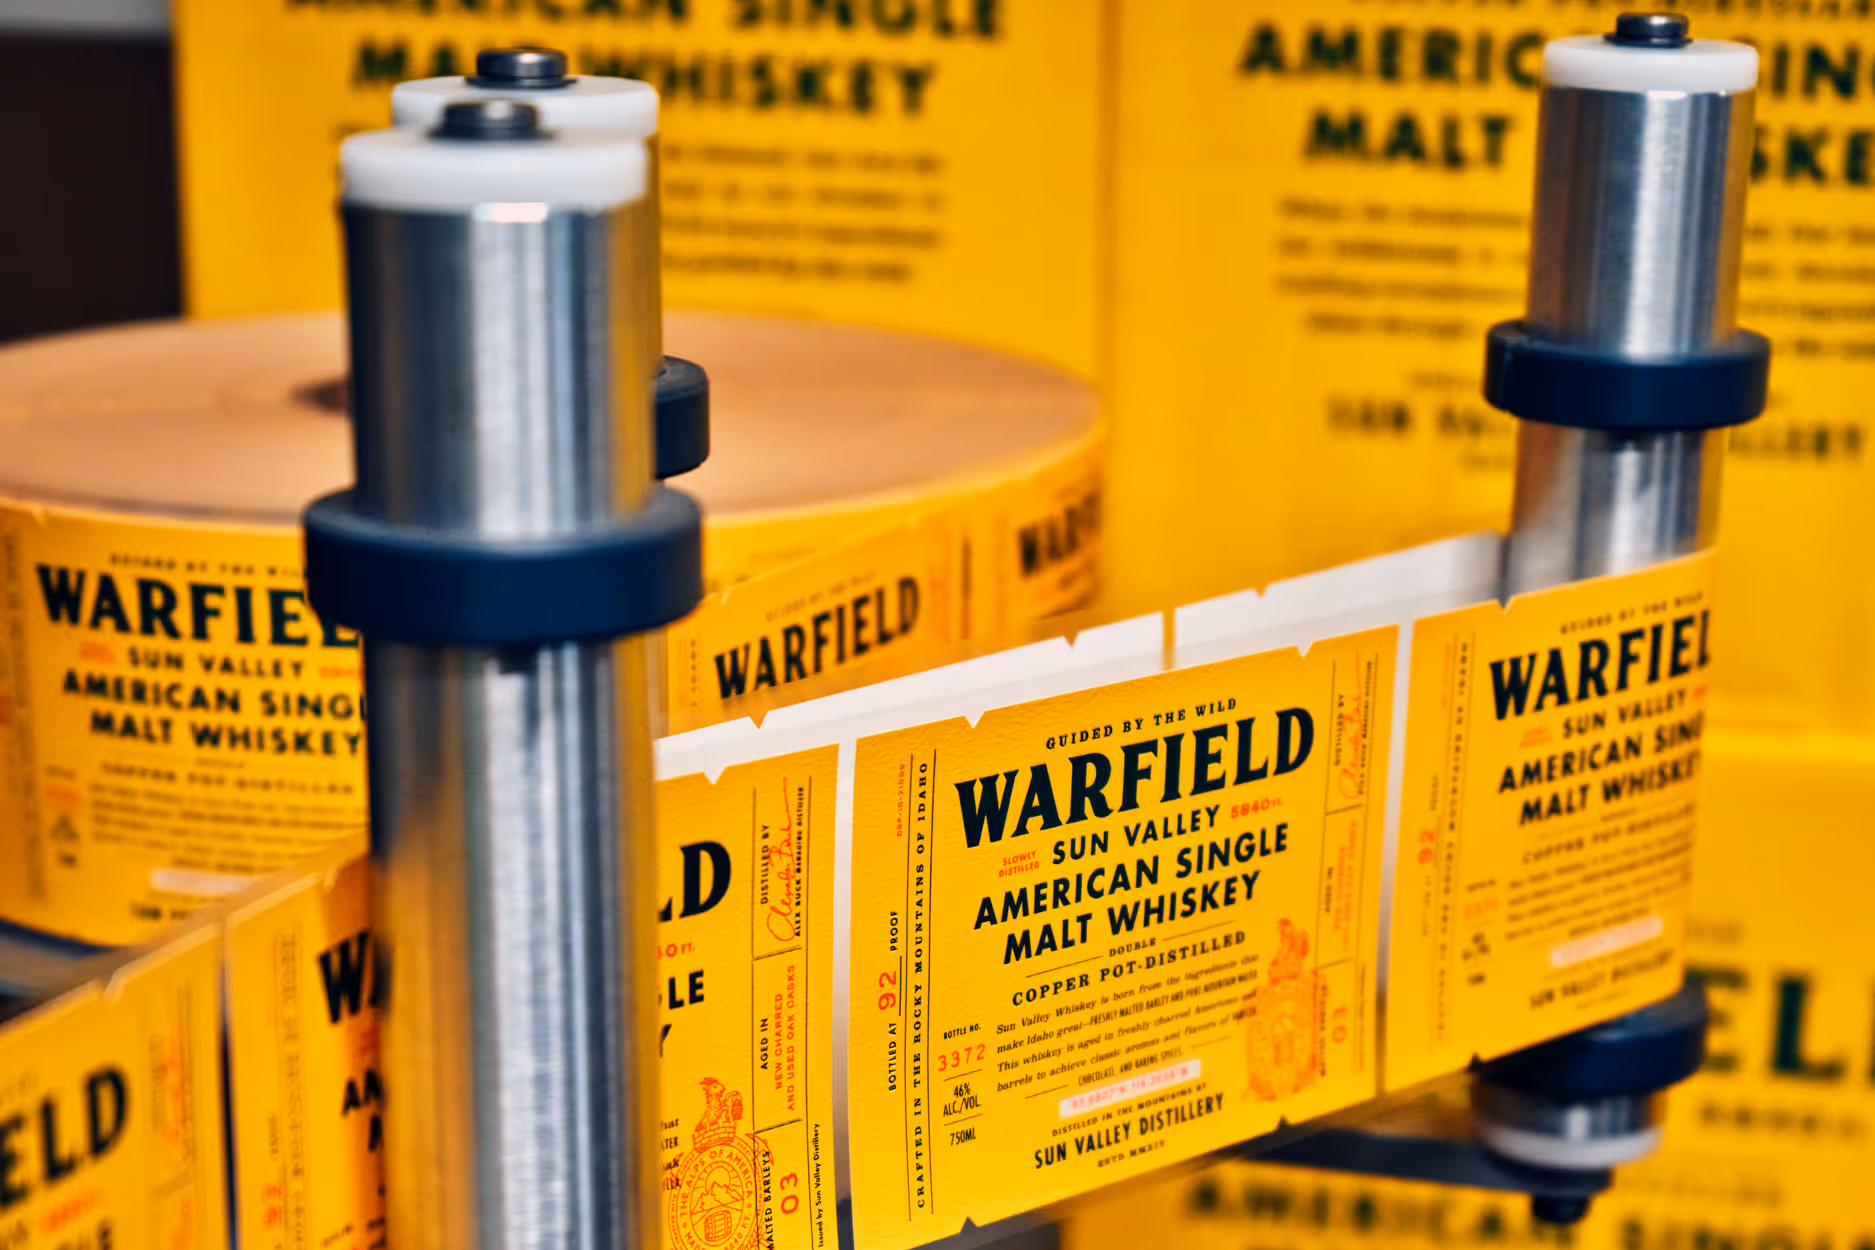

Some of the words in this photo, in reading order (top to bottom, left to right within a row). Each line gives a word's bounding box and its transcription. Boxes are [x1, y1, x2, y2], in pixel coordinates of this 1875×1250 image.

[1306, 110, 1513, 169] MALT
[713, 576, 921, 700] WARFIELD
[128, 645, 184, 671] SUN
[199, 653, 304, 679] VALLEY
[62, 668, 241, 714] AMERICAN
[90, 708, 173, 745] MALT
[190, 721, 362, 756] WHISKEY
[1046, 724, 1113, 750] GUIDED
[1122, 718, 1145, 733] BY
[1153, 709, 1186, 727] THE
[1195, 698, 1238, 718] WILD
[1563, 710, 1607, 740] SUN
[1617, 688, 1687, 723] VALLEY
[954, 707, 1315, 848] WARFIELD
[1499, 732, 1643, 795] AMERICAN
[918, 763, 928, 821] IDAHO
[1519, 783, 1591, 828] MALT
[761, 824, 770, 839] BY
[916, 833, 925, 854] OF
[1052, 830, 1109, 865] SUN
[1124, 805, 1221, 848] VALLEY
[760, 845, 770, 905] DISTILLED
[973, 855, 1160, 930] AMERICAN
[1175, 822, 1289, 879] SINGLE
[998, 861, 1041, 878] DISTILLED
[1002, 850, 1038, 867] SLOWLY
[890, 911, 898, 952] PROOF
[914, 864, 924, 973] MOUNTAINS
[1003, 912, 1093, 965] MALT
[1107, 870, 1261, 936] WHISKEY
[1012, 973, 1090, 1006] COPPER
[1099, 931, 1246, 982] POT-DISTILLED
[1109, 938, 1157, 958] DOUBLE
[786, 965, 796, 1009] CASKS
[878, 971, 897, 1011] 92
[760, 1018, 769, 1032] IN
[775, 993, 783, 1057] CHARRED
[786, 1014, 795, 1040] OAK
[889, 1023, 897, 1036] AT
[913, 984, 922, 1044] ROCKY
[996, 1022, 1016, 1035] Sun
[1021, 1012, 1051, 1028] Valley
[1055, 1000, 1097, 1017] Whiskey
[1101, 995, 1109, 1005] is
[1113, 988, 1135, 1002] born
[1139, 982, 1162, 994] from
[944, 1026, 967, 1040] BOTTLE
[969, 1023, 982, 1033] NO.
[997, 1038, 1025, 1054] make
[1027, 1030, 1055, 1046] Idaho
[998, 1060, 1020, 1073] This
[1023, 1047, 1063, 1065] whiskey
[1066, 1042, 1075, 1053] is
[1078, 1034, 1101, 1049] aged
[1105, 1031, 1114, 1041] in
[760, 1037, 769, 1070] AGED
[787, 1045, 795, 1080] USED
[889, 1041, 897, 1092] BOTTLED
[913, 1053, 921, 1088] THE
[937, 1043, 986, 1072] 3372
[997, 1074, 1033, 1092] barrels
[1037, 1070, 1047, 1081] to
[1050, 1058, 1087, 1076] achieve
[1090, 1048, 1121, 1065] classic
[775, 1062, 784, 1090] NEW
[953, 1082, 971, 1098] 46%
[787, 1085, 796, 1111] AND
[914, 1098, 922, 1116] IN
[812, 1123, 820, 1161] Distillery
[950, 1127, 977, 1147] 750ML
[1034, 1142, 1067, 1169] SUN
[1075, 1121, 1131, 1156] VALLEY
[1139, 1092, 1224, 1136] DISTILLERY
[1052, 1116, 1098, 1137] DISTILLED
[1102, 1112, 1113, 1122] IN
[1117, 1106, 1133, 1117] THE
[680, 1192, 690, 1217] THE
[685, 1157, 706, 1188] ALPS
[709, 1149, 724, 1160] OF
[726, 1151, 754, 1198] AMERICA
[762, 1151, 772, 1203] BARLEYS
[813, 1163, 822, 1189] Valley
[914, 1126, 925, 1208] CRAFTED
[780, 1172, 799, 1215] 03
[816, 1208, 824, 1219] by
